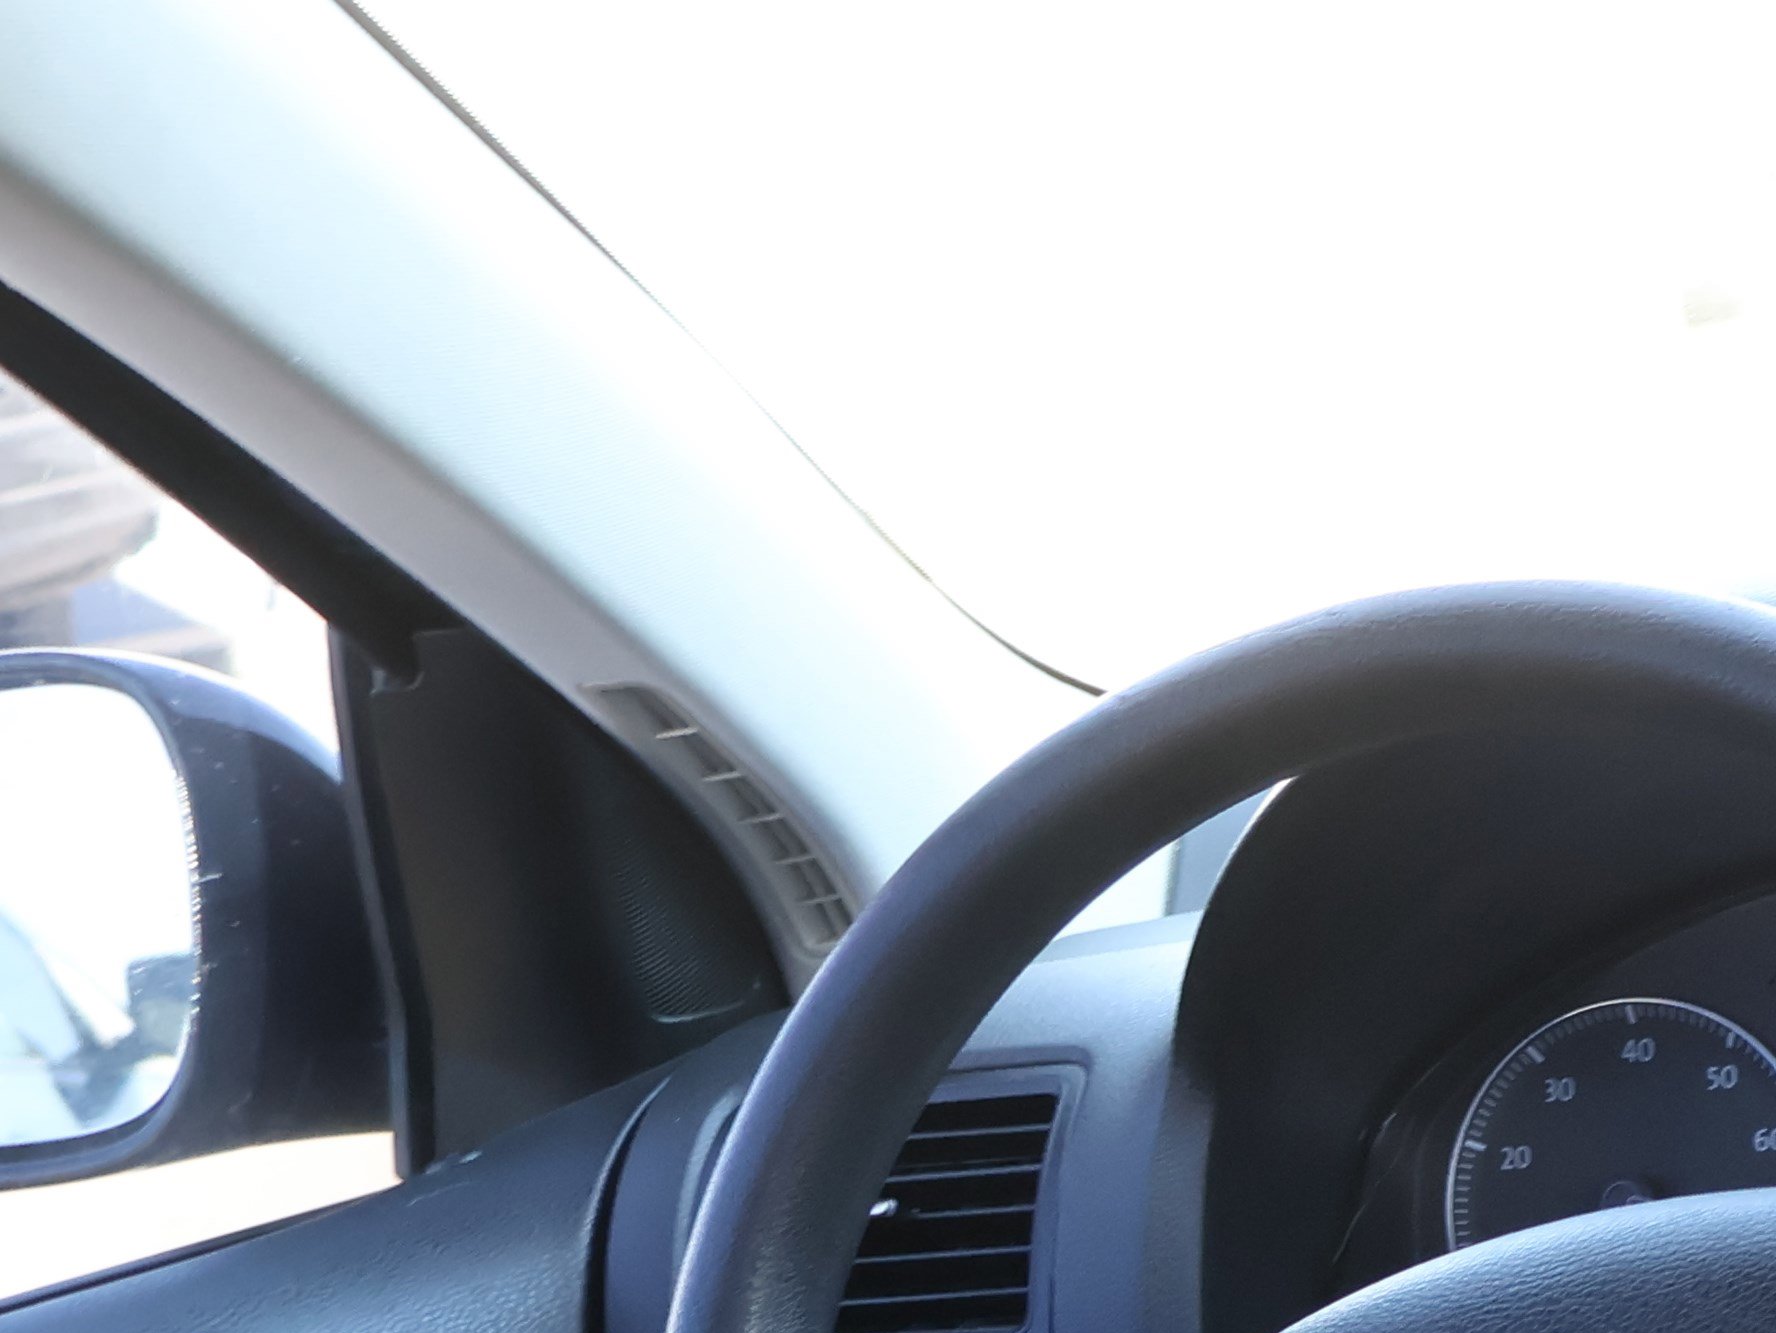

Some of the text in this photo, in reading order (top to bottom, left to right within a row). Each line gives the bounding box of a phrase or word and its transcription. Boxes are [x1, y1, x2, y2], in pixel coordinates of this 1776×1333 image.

[1620, 1038, 1655, 1062] 40
[1706, 1065, 1738, 1090] 50
[1545, 1077, 1576, 1103] 30
[1500, 1146, 1533, 1170] 20
